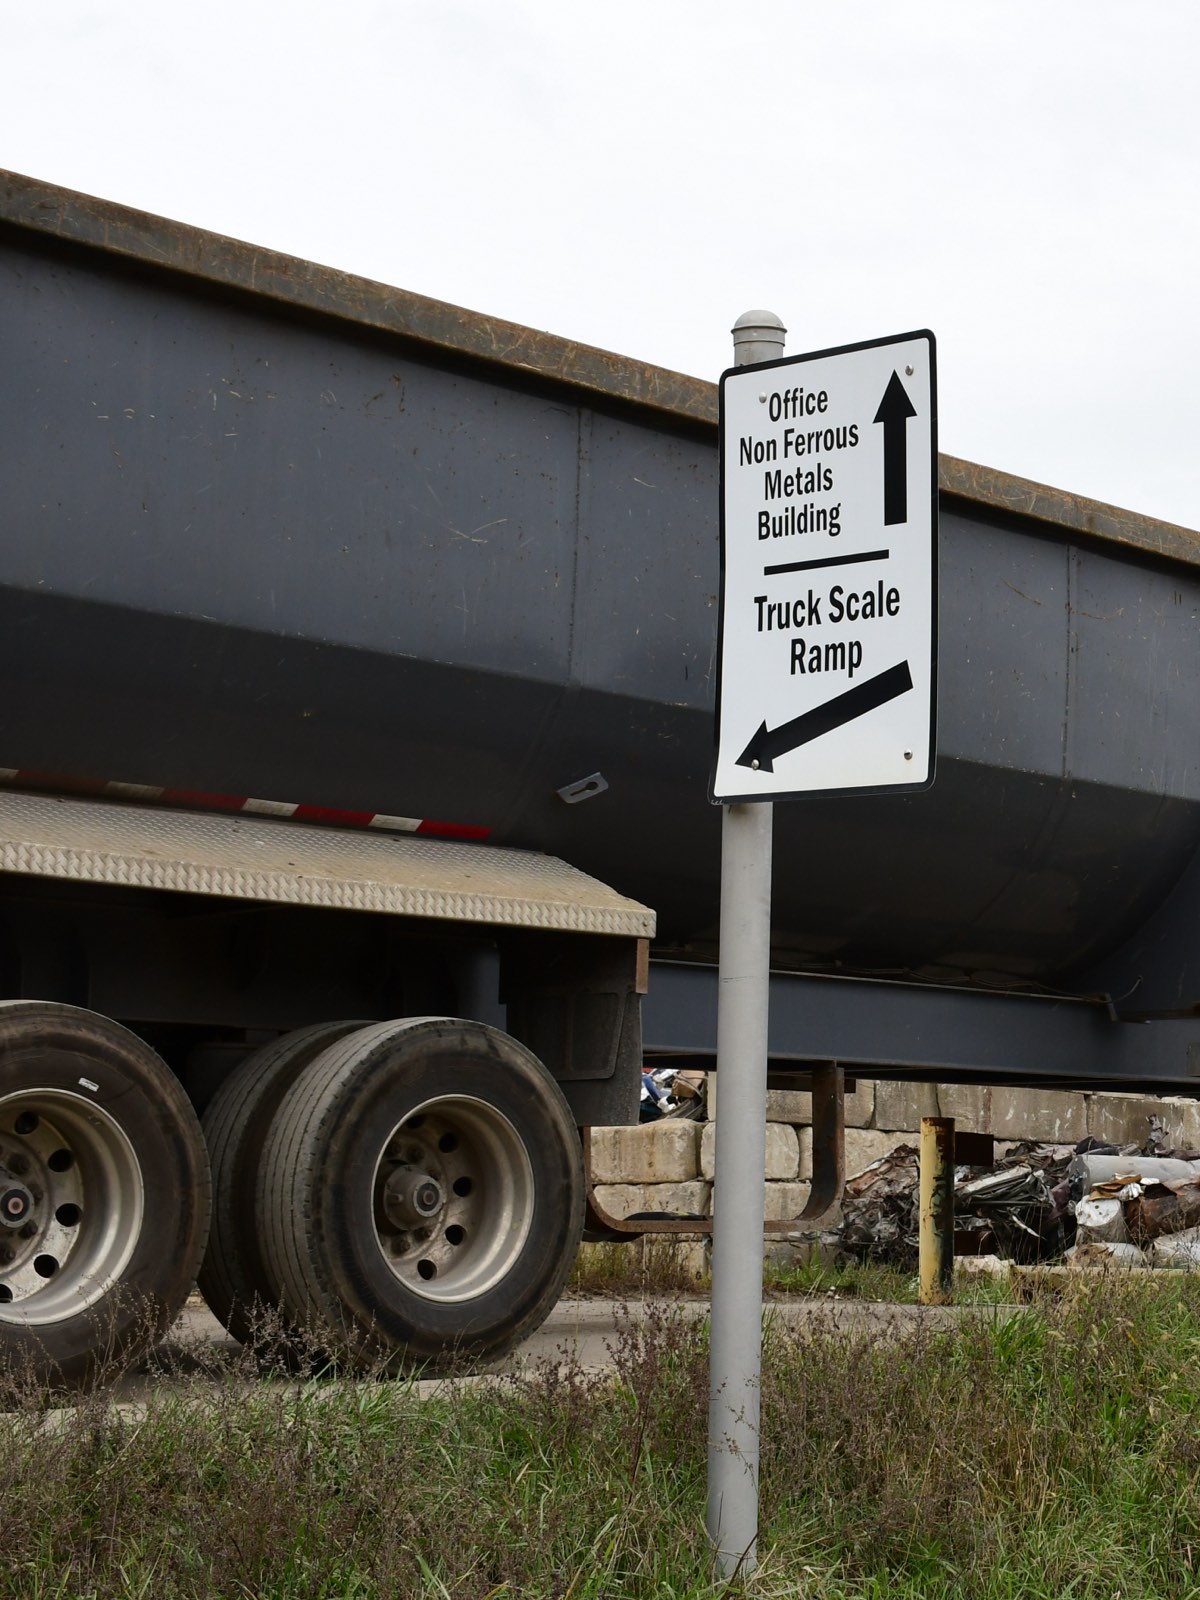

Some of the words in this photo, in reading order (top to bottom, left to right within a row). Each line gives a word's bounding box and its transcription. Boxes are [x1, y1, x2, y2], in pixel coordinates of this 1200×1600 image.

[769, 387, 828, 422] Office
[740, 436, 777, 466] Non
[784, 424, 859, 458] Ferrous
[764, 463, 833, 500] Metals
[758, 503, 841, 541] Building
[754, 589, 822, 632] Truck
[828, 580, 900, 623] Scale
[790, 638, 863, 678] Ramp
